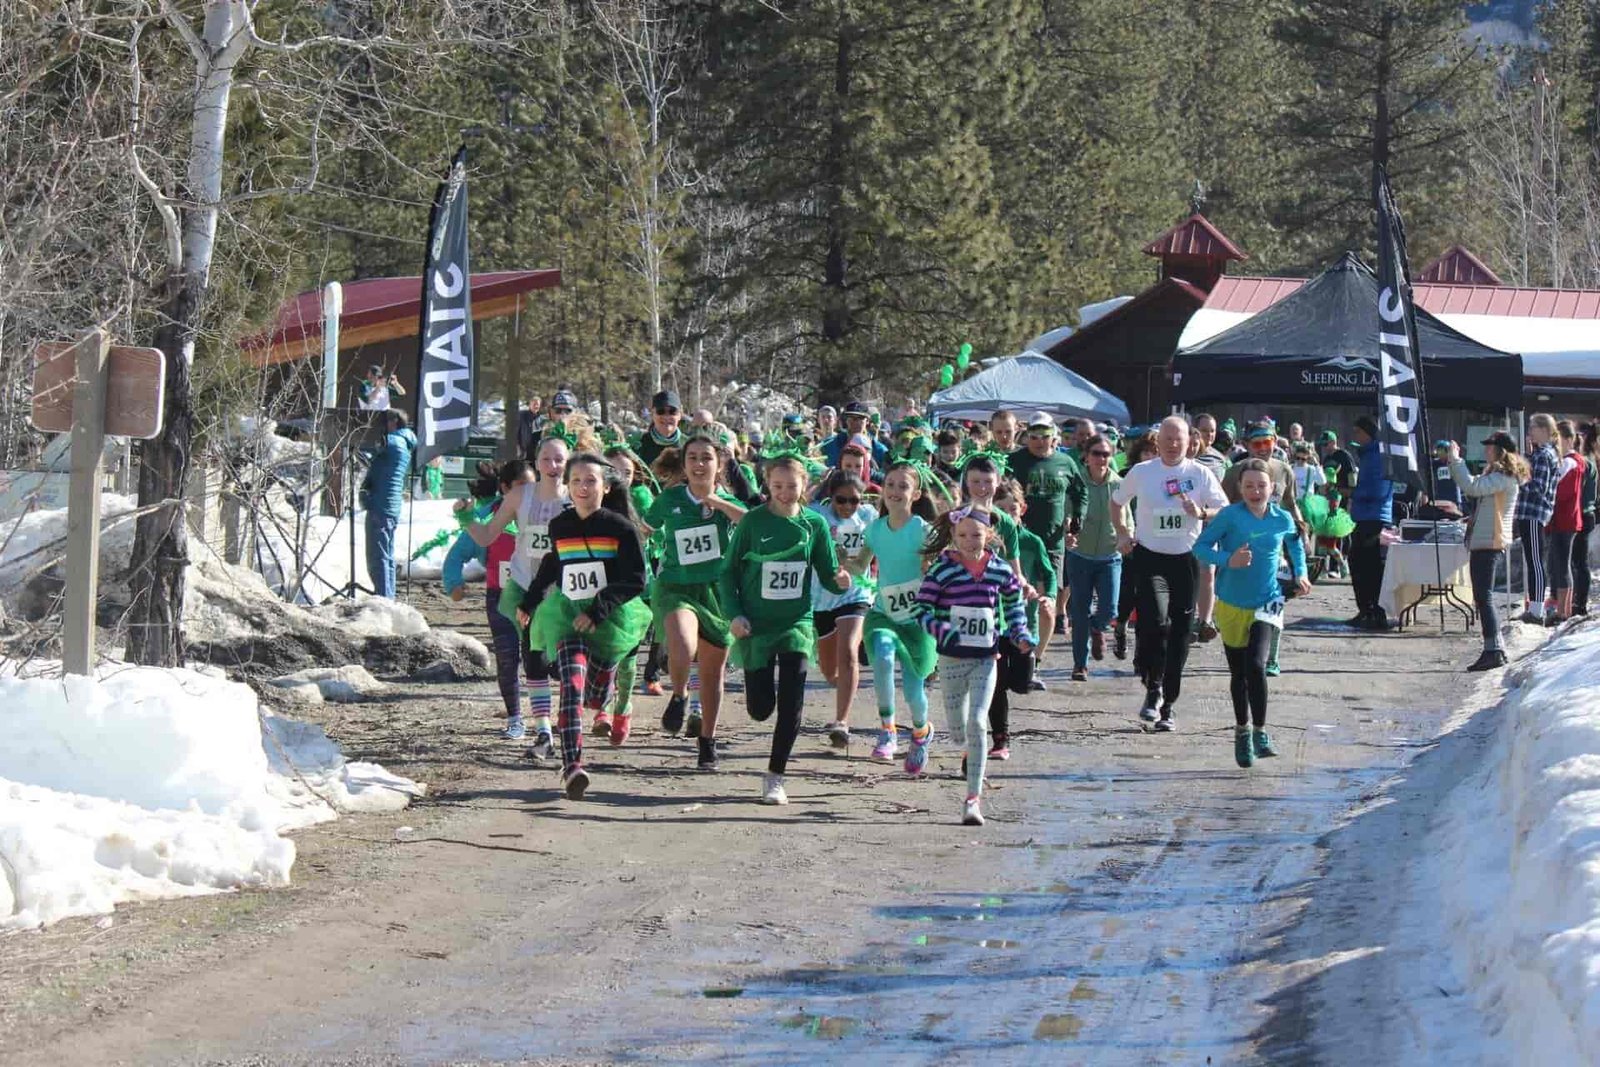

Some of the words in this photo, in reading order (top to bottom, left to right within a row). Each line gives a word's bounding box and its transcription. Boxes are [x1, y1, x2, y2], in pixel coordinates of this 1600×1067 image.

[1300, 370, 1358, 385] SLEEPING
[1362, 370, 1380, 385] LA
[1160, 515, 1182, 529] 148
[532, 533, 550, 549] 25
[683, 534, 712, 554] 245
[568, 570, 599, 592] 304
[770, 571, 798, 589] 250
[959, 616, 988, 636] 260
